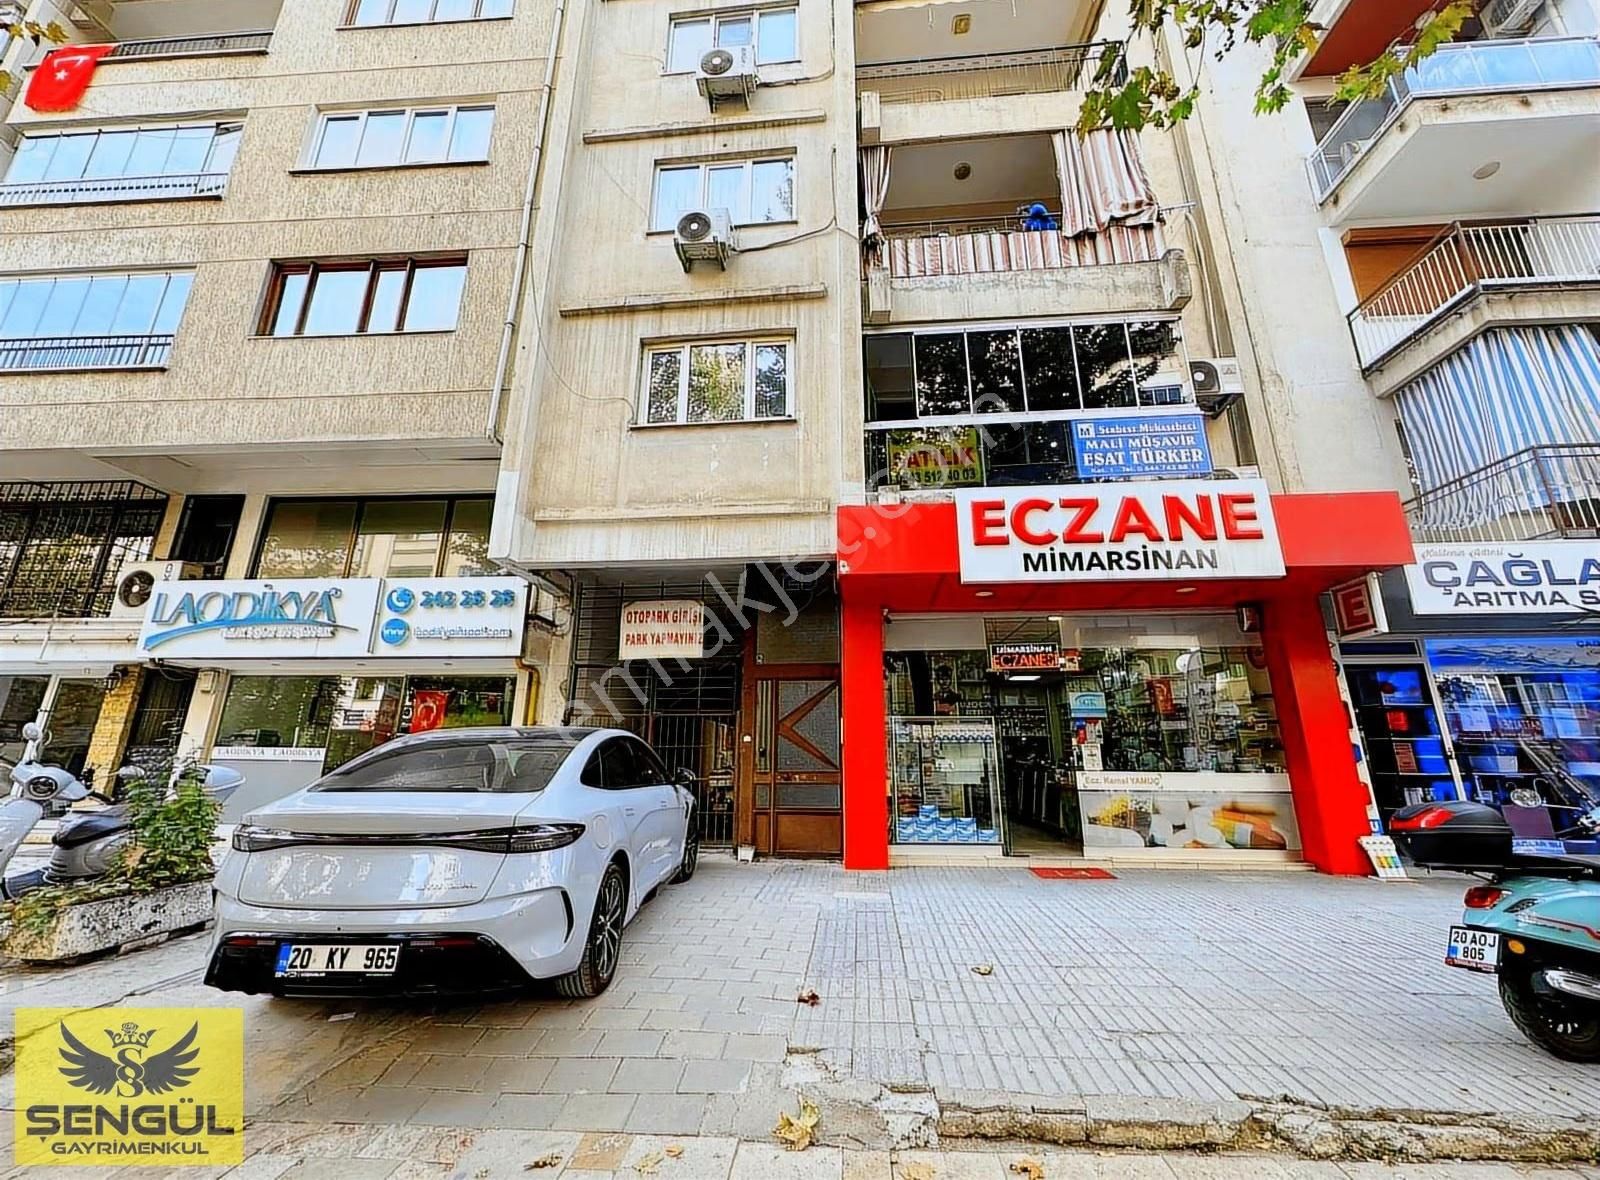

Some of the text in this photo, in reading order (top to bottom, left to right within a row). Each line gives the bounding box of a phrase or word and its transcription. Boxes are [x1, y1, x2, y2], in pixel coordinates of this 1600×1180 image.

[1128, 434, 1196, 449] MÜŞAVİR
[1083, 447, 1204, 466] ESAT TÜRKER
[970, 492, 1265, 547] ECZANE
[1022, 543, 1219, 573] MİMARSİNAN
[151, 583, 337, 625] LAODİKYA
[1454, 590, 1571, 607] ARITMA
[626, 608, 669, 624] OTOPARK
[625, 631, 703, 647] PARK YAPMAYINIZ
[1453, 930, 1497, 948] 20 AOJ
[288, 948, 397, 970] 20 KY 965
[1462, 946, 1485, 961] 805
